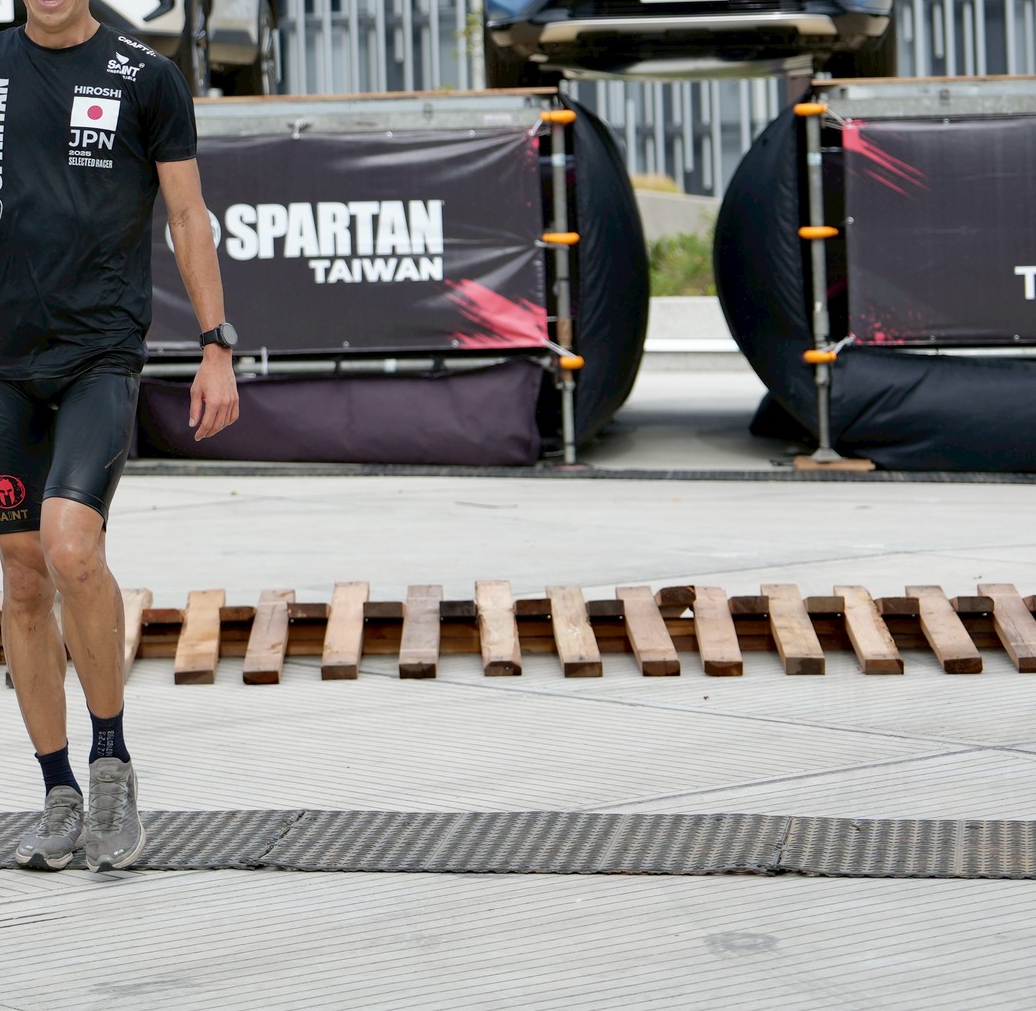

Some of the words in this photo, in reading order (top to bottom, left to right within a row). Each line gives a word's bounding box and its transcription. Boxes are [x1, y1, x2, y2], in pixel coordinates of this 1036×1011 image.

[118, 36, 149, 51] CRAFT
[107, 59, 140, 77] SAINT
[74, 86, 122, 98] HIROSHI
[68, 129, 115, 150] JPN
[68, 157, 95, 167] SELECTED
[95, 159, 113, 168] RACER
[225, 200, 443, 260] SPARTAN
[309, 257, 443, 283] TAIWAN
